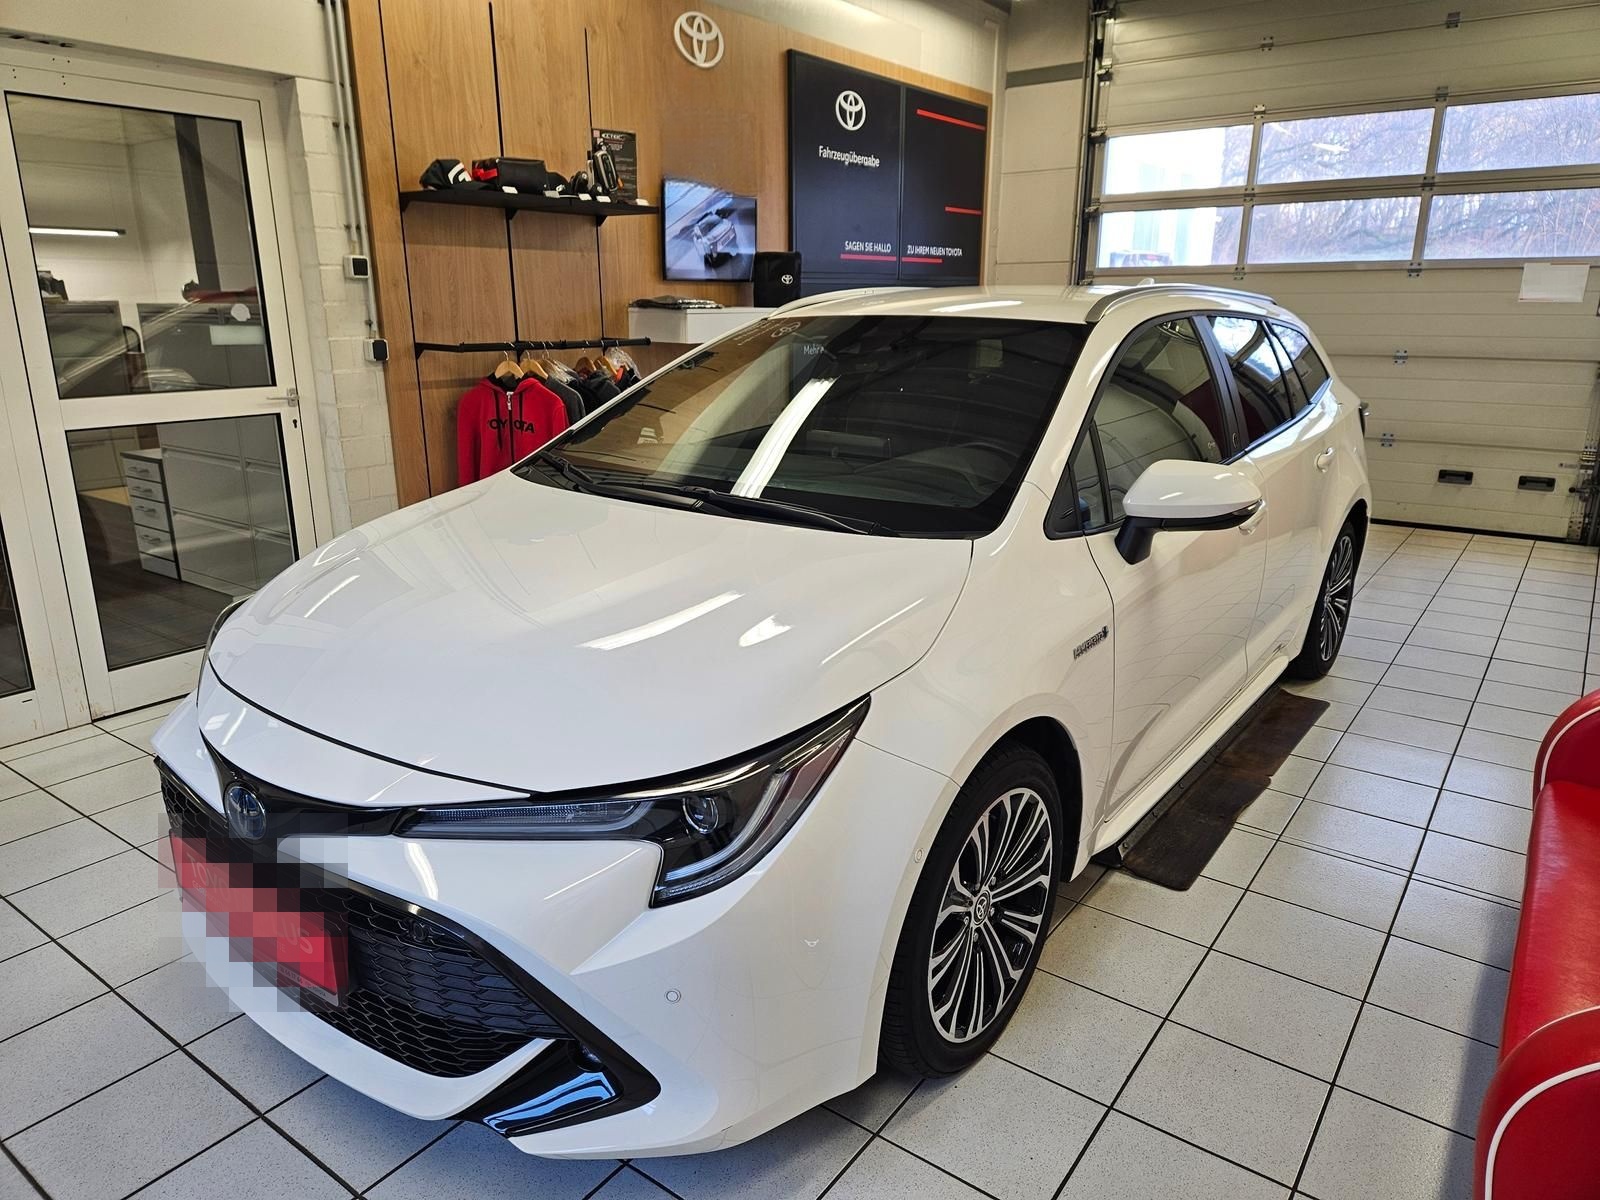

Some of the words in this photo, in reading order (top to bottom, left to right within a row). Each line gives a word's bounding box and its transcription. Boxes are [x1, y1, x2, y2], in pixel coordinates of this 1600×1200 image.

[819, 145, 880, 167] Fahrzeugübergabe
[844, 240, 865, 252] SAGEN
[865, 241, 873, 252] SIE
[873, 242, 892, 253] HALLO
[907, 244, 915, 254] ZU
[915, 245, 930, 255] IHREM
[930, 246, 946, 256] NEUEN
[946, 247, 963, 257] TOYOTA
[487, 418, 535, 433] OYOTA
